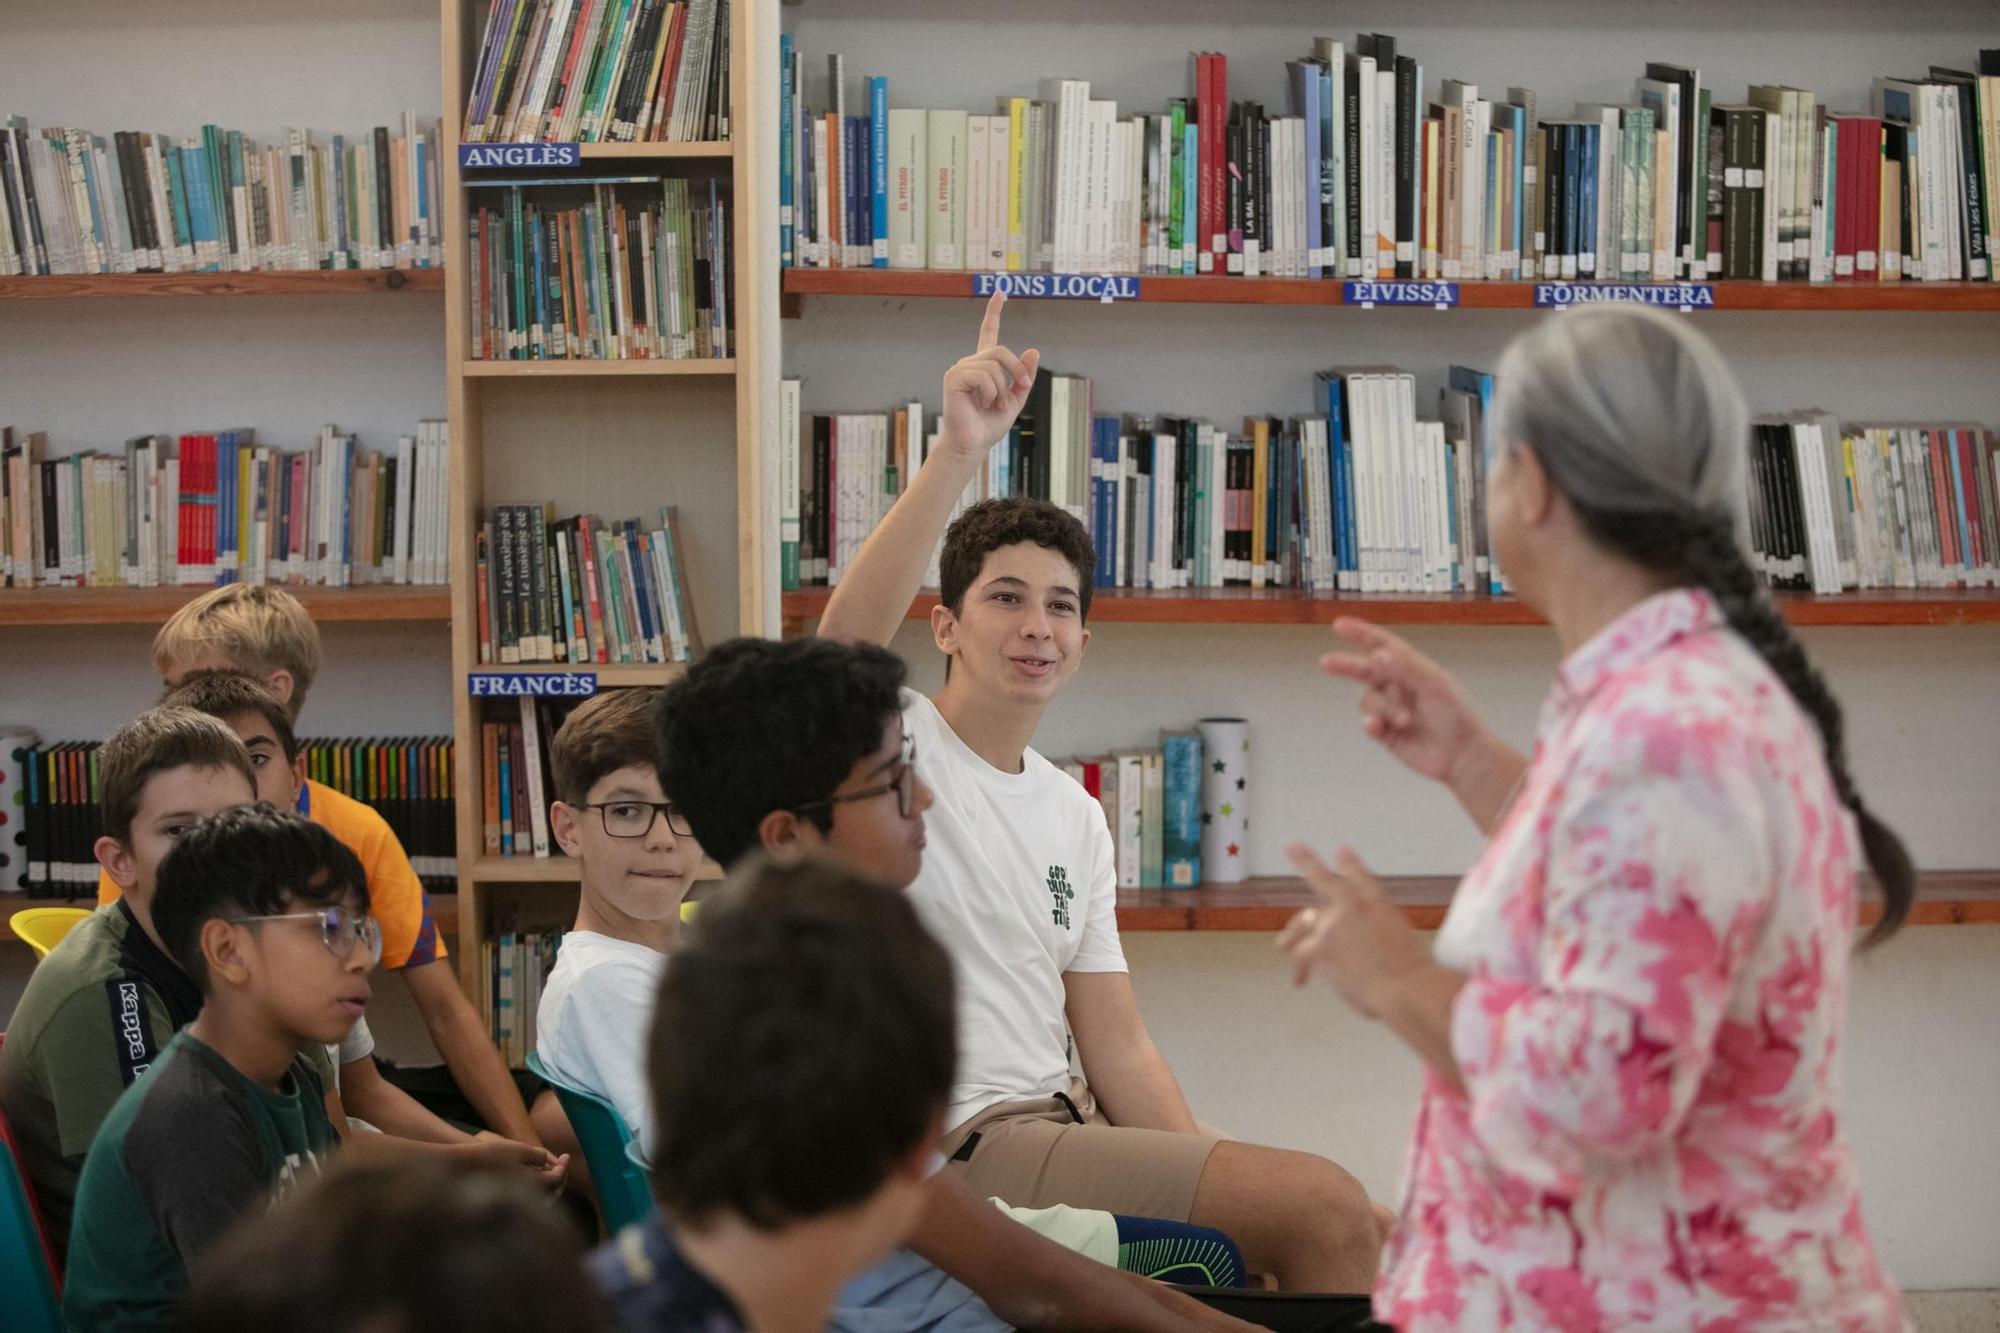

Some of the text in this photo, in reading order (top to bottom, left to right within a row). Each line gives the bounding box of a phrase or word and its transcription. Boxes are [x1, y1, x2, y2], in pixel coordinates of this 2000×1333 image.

[1465, 100, 1475, 148] Tur Costa
[464, 143, 573, 166] ANGLÈS
[899, 168, 908, 211] EL PITIUSO
[939, 168, 948, 212] EL PITIUSO
[1968, 173, 1978, 206] Feixes
[1246, 199, 1255, 218] SAL
[1350, 208, 1357, 217] EL
[1971, 208, 1980, 224] ses
[1247, 220, 1255, 233] LA
[1973, 233, 1982, 254] Vila
[980, 275, 1137, 298] FONS LOCAL
[1353, 282, 1454, 302] EIVISSA
[1538, 285, 1713, 305] FORMENTERA
[499, 512, 510, 527] été
[517, 512, 526, 527] été
[501, 530, 513, 577] deuxième
[518, 530, 529, 578] troisième
[502, 580, 513, 594] Le
[520, 582, 530, 596] Le
[471, 673, 594, 695] FRANCÈS
[119, 982, 146, 1061] Kappa
